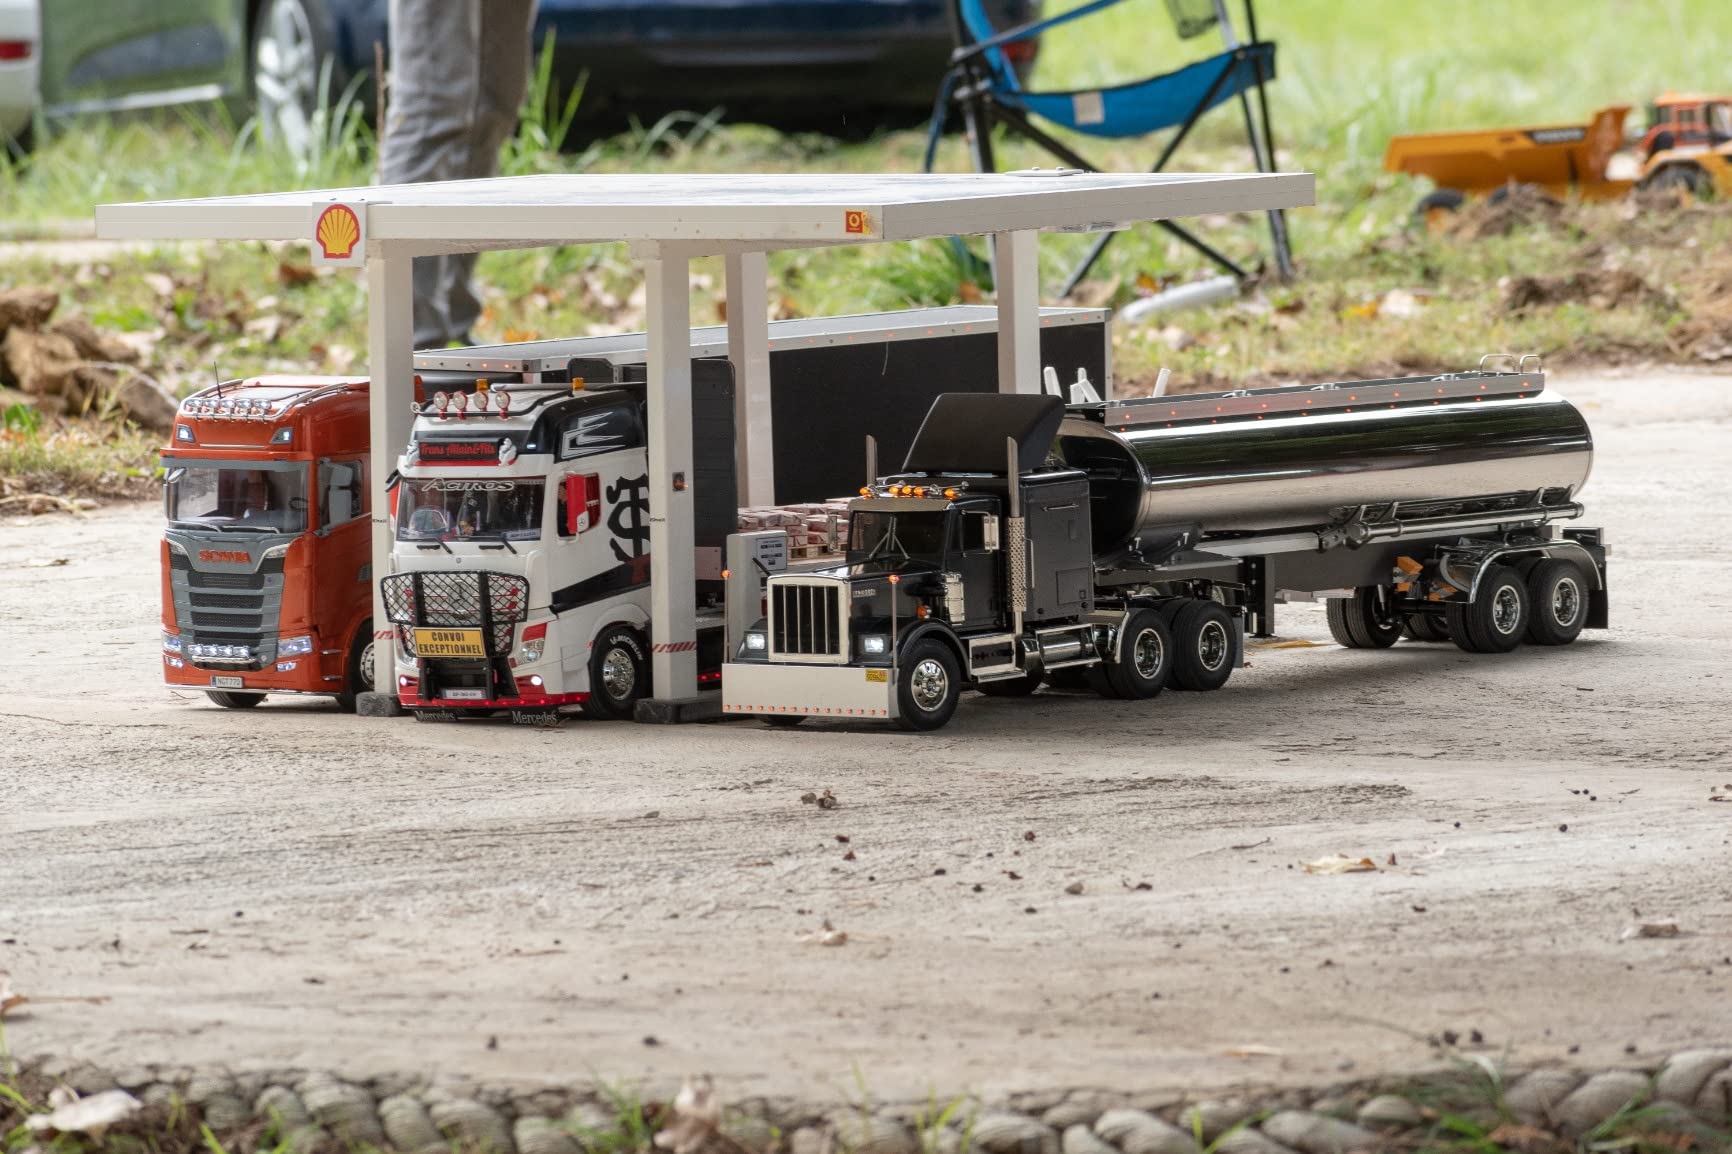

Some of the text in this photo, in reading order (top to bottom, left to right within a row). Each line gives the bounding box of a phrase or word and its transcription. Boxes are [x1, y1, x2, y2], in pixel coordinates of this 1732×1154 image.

[198, 549, 251, 564] SCANIA
[431, 631, 465, 642] CONVOI
[419, 643, 482, 654] EXCEPTIONNEL
[511, 710, 558, 724] Mercedes
